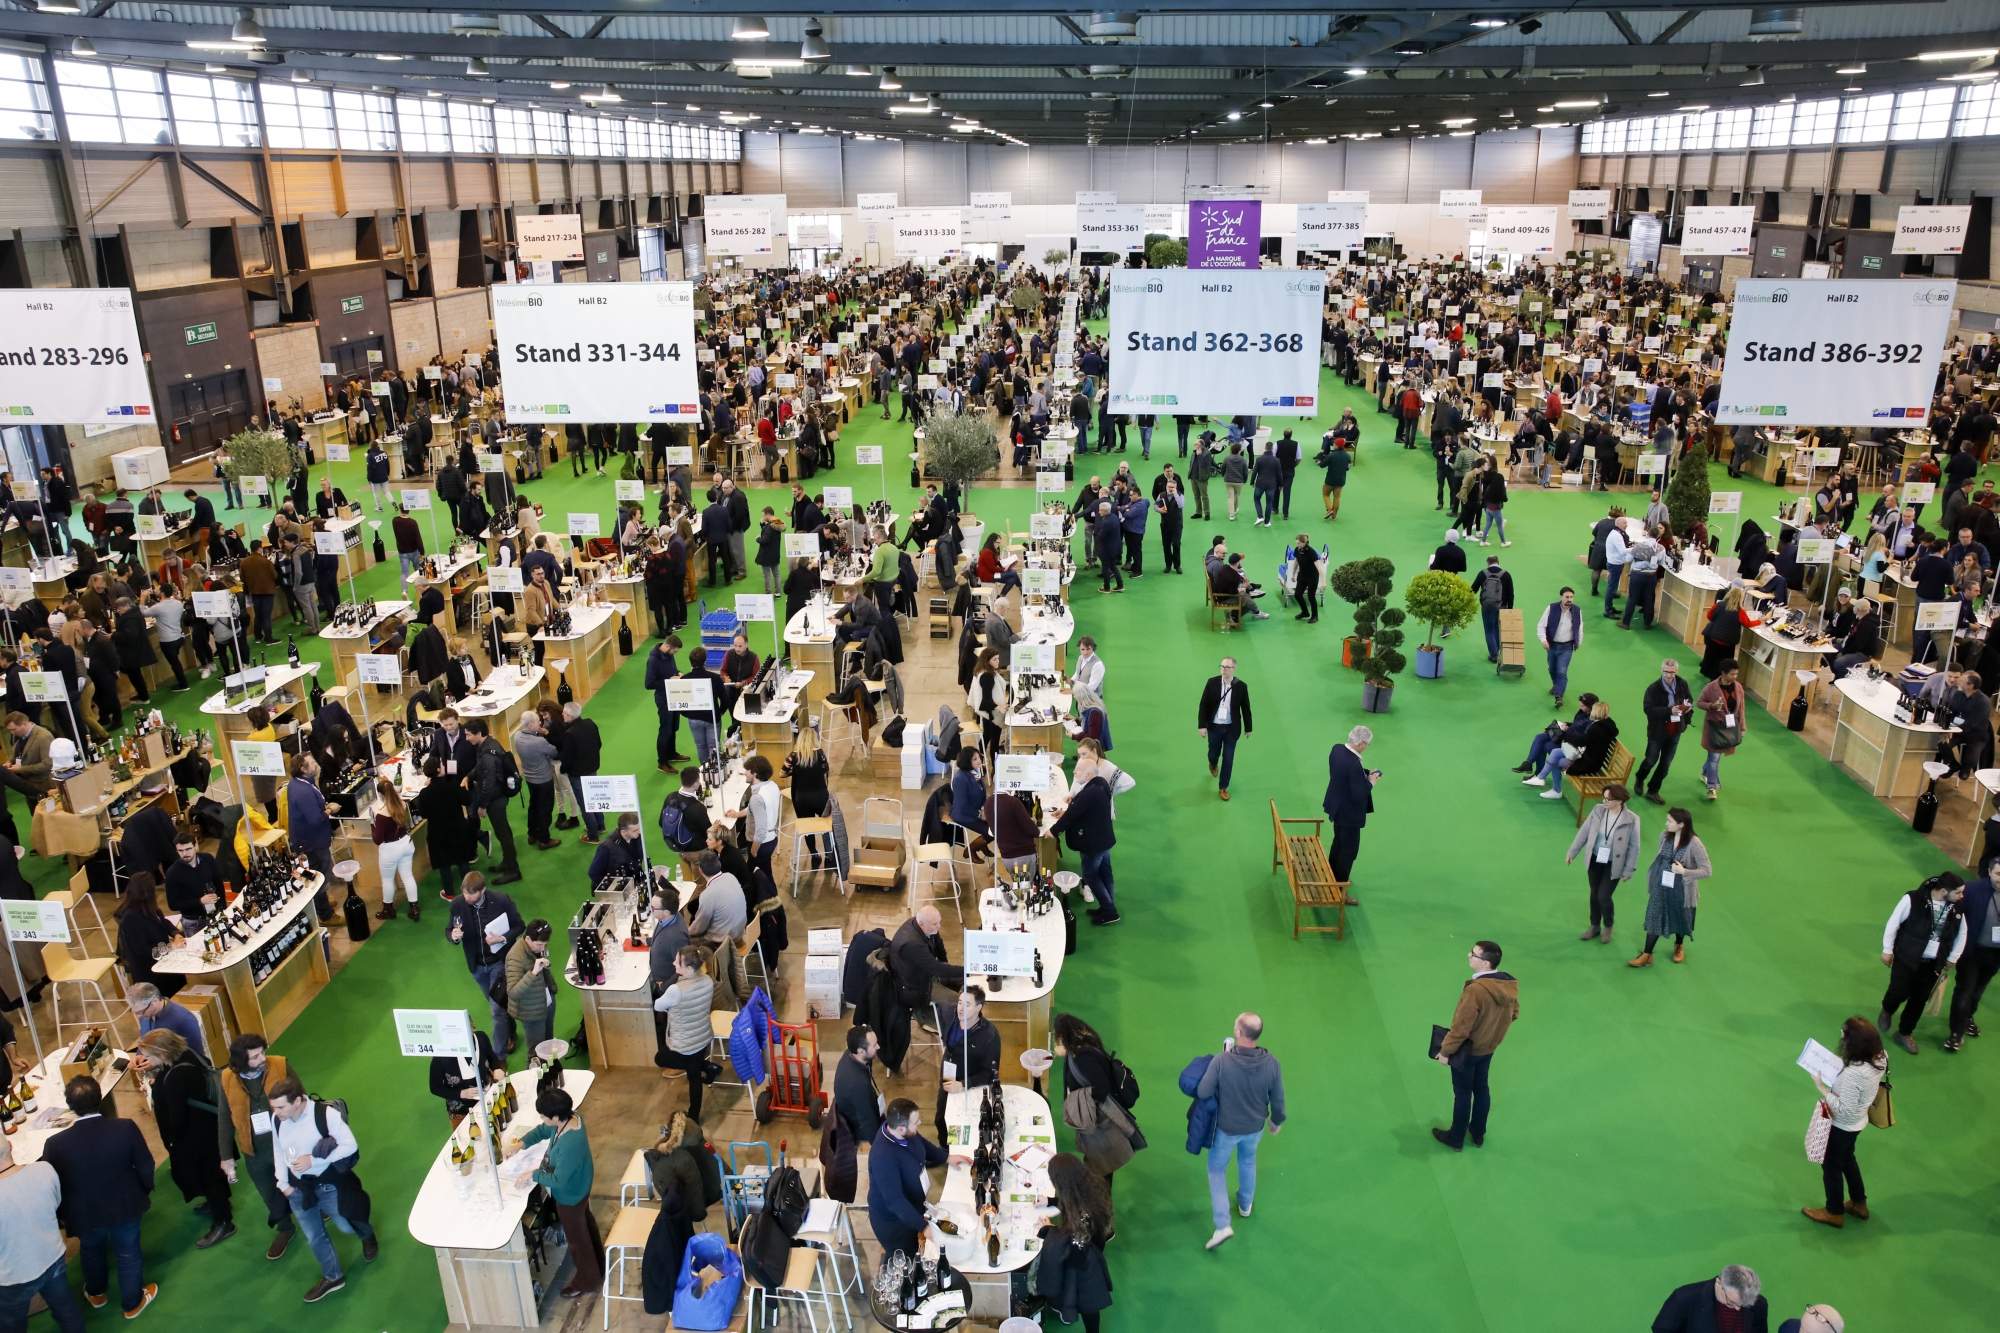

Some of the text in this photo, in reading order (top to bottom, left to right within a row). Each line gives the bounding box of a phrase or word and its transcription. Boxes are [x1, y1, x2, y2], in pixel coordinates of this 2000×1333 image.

[1218, 210, 1244, 226] Sud
[1206, 228, 1248, 250] France
[1220, 226, 1236, 236] de
[1202, 284, 1219, 293] Hall
[197, 331, 216, 340] SECOURS
[1128, 331, 1303, 352] Stand 362-368
[0, 347, 128, 366] and 283-296
[515, 342, 680, 362] Stand 331-344
[1743, 342, 1923, 363] Stand 386-392
[983, 964, 998, 972] 368
[418, 1044, 434, 1053] 344
